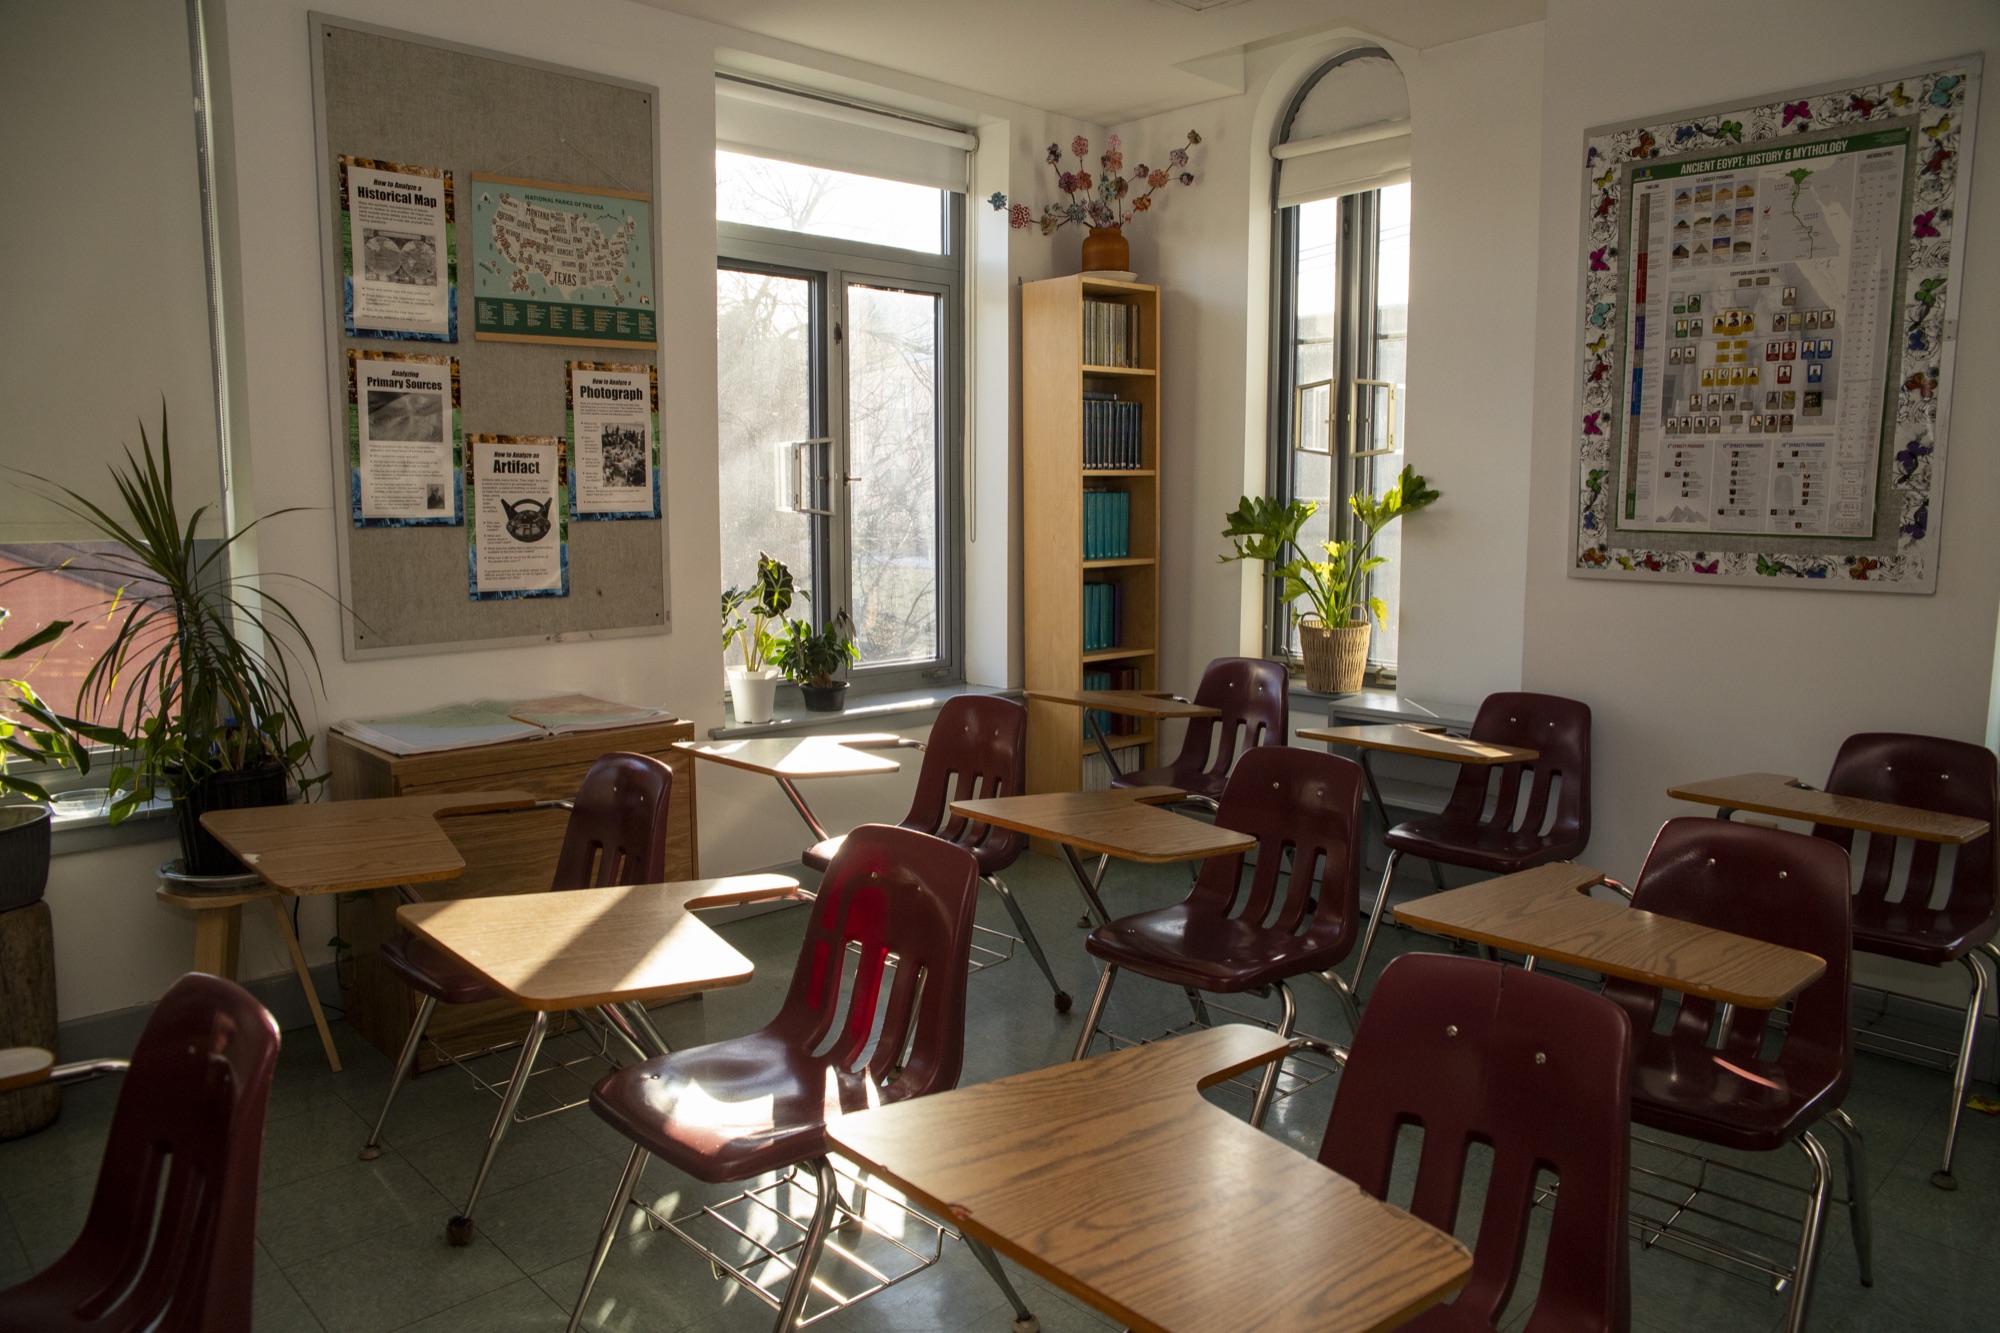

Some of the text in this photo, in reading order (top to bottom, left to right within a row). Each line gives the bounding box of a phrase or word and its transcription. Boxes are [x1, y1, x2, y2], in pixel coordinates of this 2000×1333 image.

[1680, 140, 1848, 174] ANCIENT EGYPT: HISTORY & MYTHOLOGY
[374, 179, 386, 187] How
[394, 182, 416, 191] Analyze
[358, 186, 437, 208] Historical Map
[525, 194, 554, 204] NATIONAL
[555, 198, 573, 206] PARKS
[557, 248, 574, 257] KANSAS
[554, 271, 577, 286] TEXAS
[392, 370, 419, 378] Analyzing
[368, 377, 442, 390] Primary Sources
[580, 386, 643, 401] Photograph
[493, 460, 540, 474] Artifact
